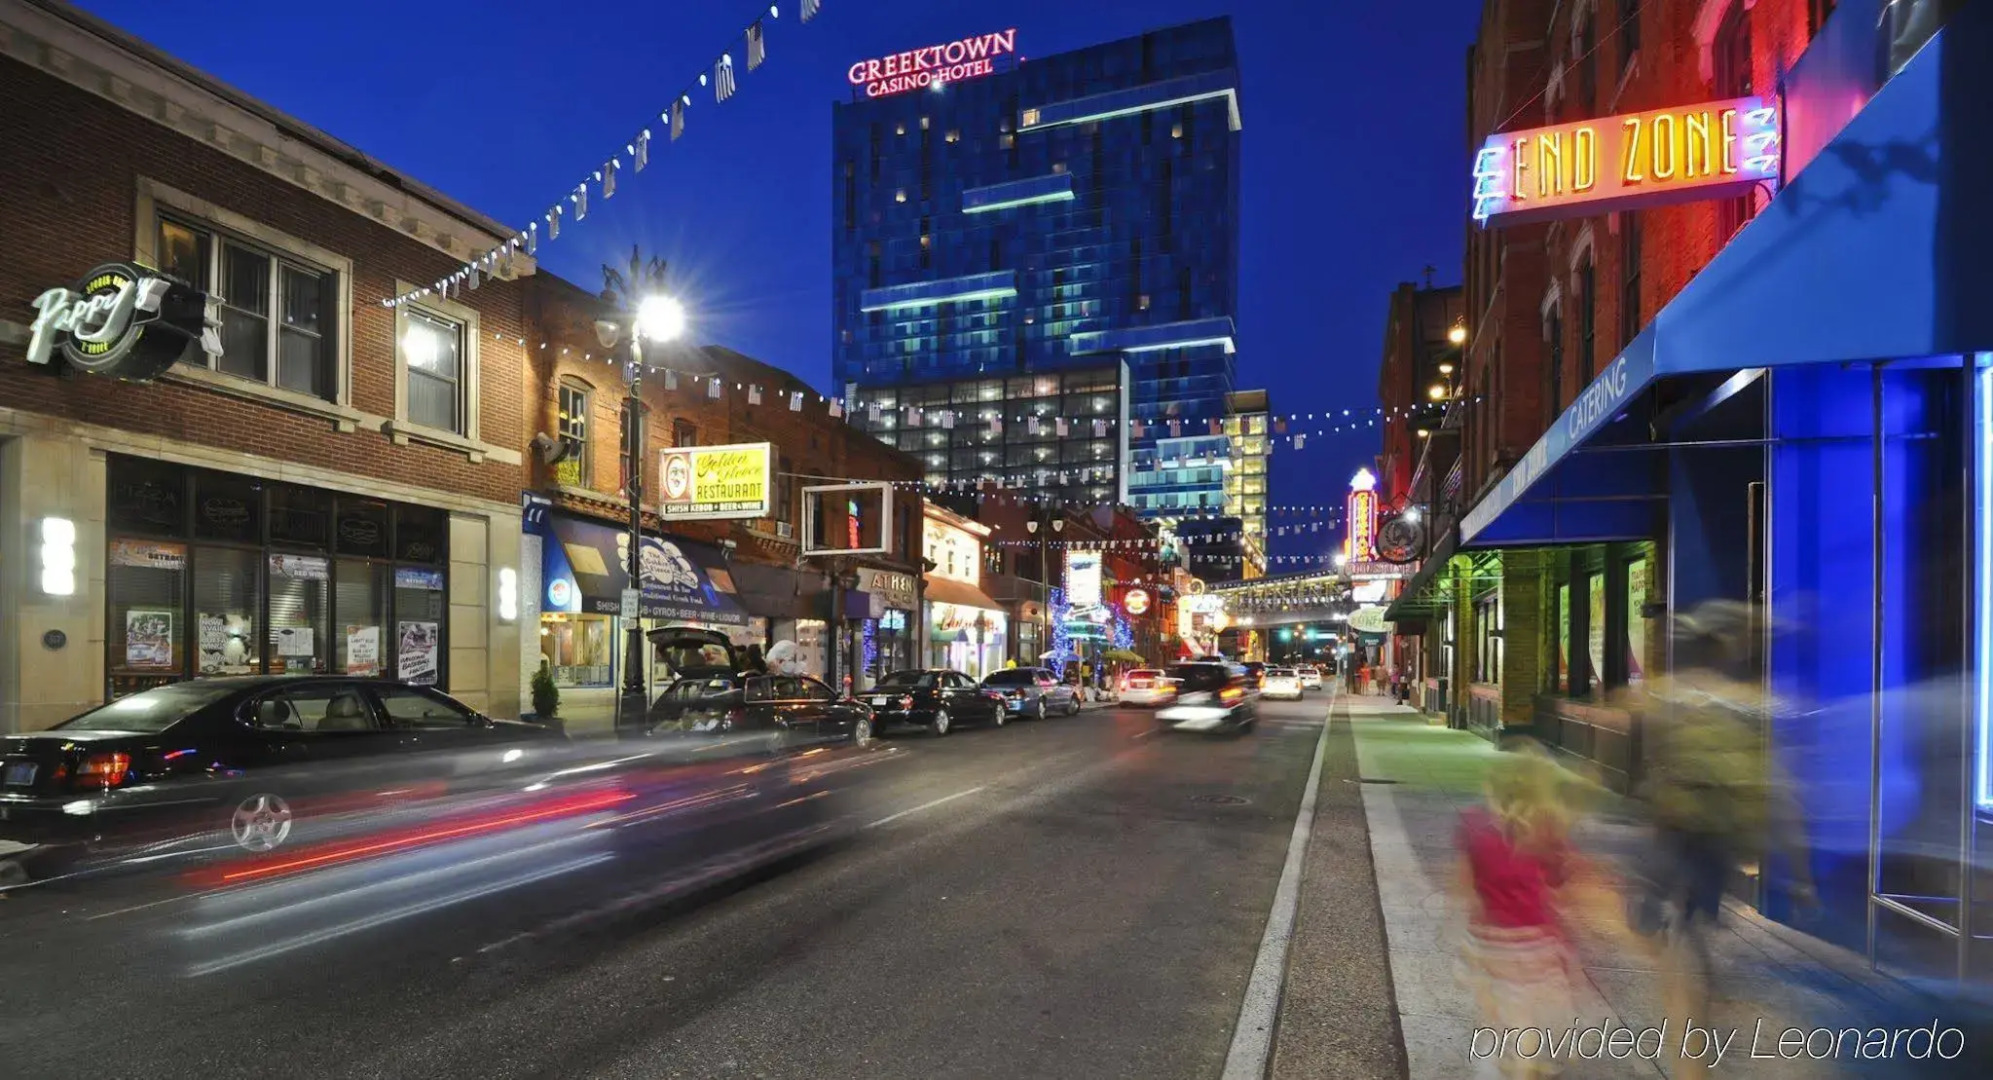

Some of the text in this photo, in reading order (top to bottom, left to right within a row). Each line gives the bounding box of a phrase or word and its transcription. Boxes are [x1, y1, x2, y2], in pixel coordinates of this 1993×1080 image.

[848, 28, 1016, 84] GREEKTOWN
[1512, 108, 1738, 202] END ZONE
[1569, 357, 1627, 439] CATERING
[697, 483, 762, 499] RESTAURANT
[667, 504, 689, 513] SHISH
[691, 503, 713, 512] KEBOB
[871, 573, 914, 593] ATHEN
[596, 600, 620, 612] SHISH
[653, 605, 676, 617] GYROS
[680, 608, 697, 618] BEER
[700, 611, 716, 621] WINE
[719, 613, 741, 623] LIQUOR
